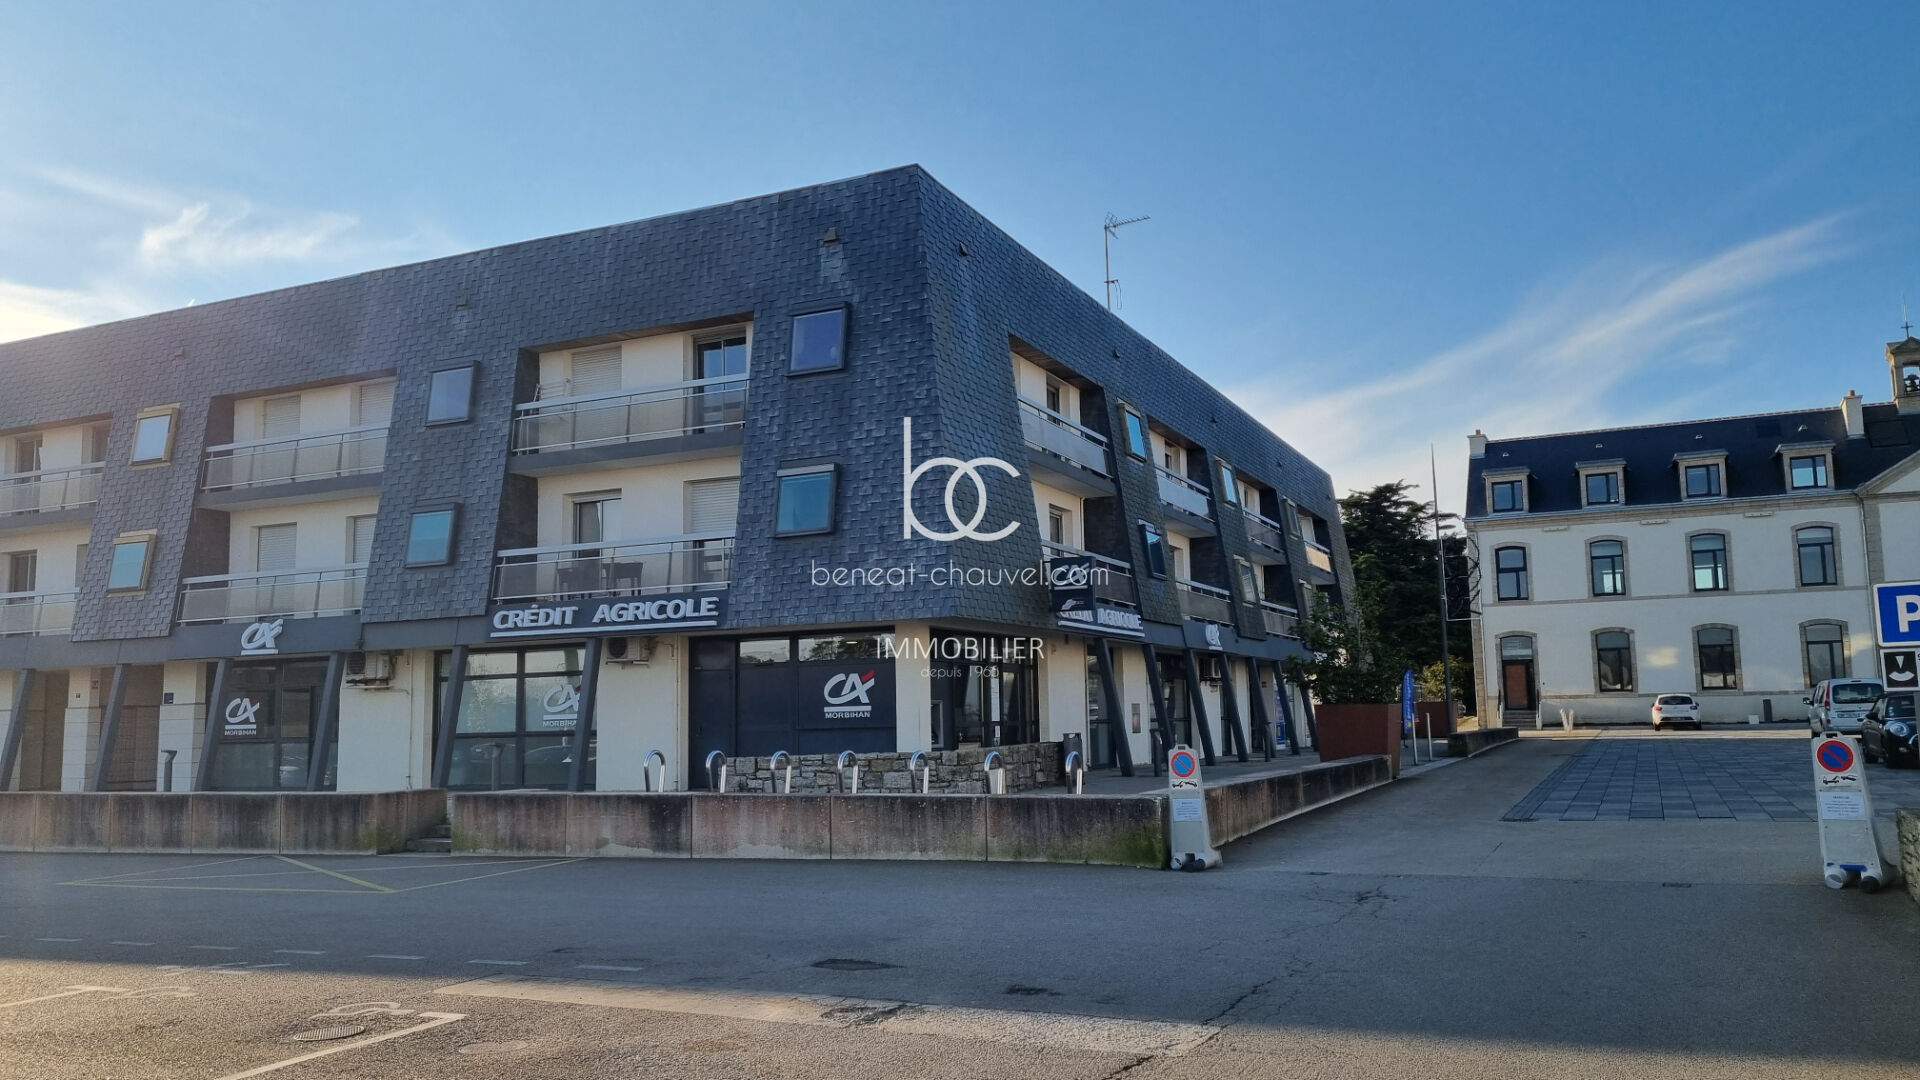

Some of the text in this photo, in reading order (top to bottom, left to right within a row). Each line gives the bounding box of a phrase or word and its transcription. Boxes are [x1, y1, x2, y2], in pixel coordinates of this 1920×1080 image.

[493, 597, 720, 629] CRÉDIT AGRICOLE
[1896, 594, 1920, 633] P
[543, 720, 577, 728] MORBIHA
[825, 711, 871, 719] MORBIHAN
